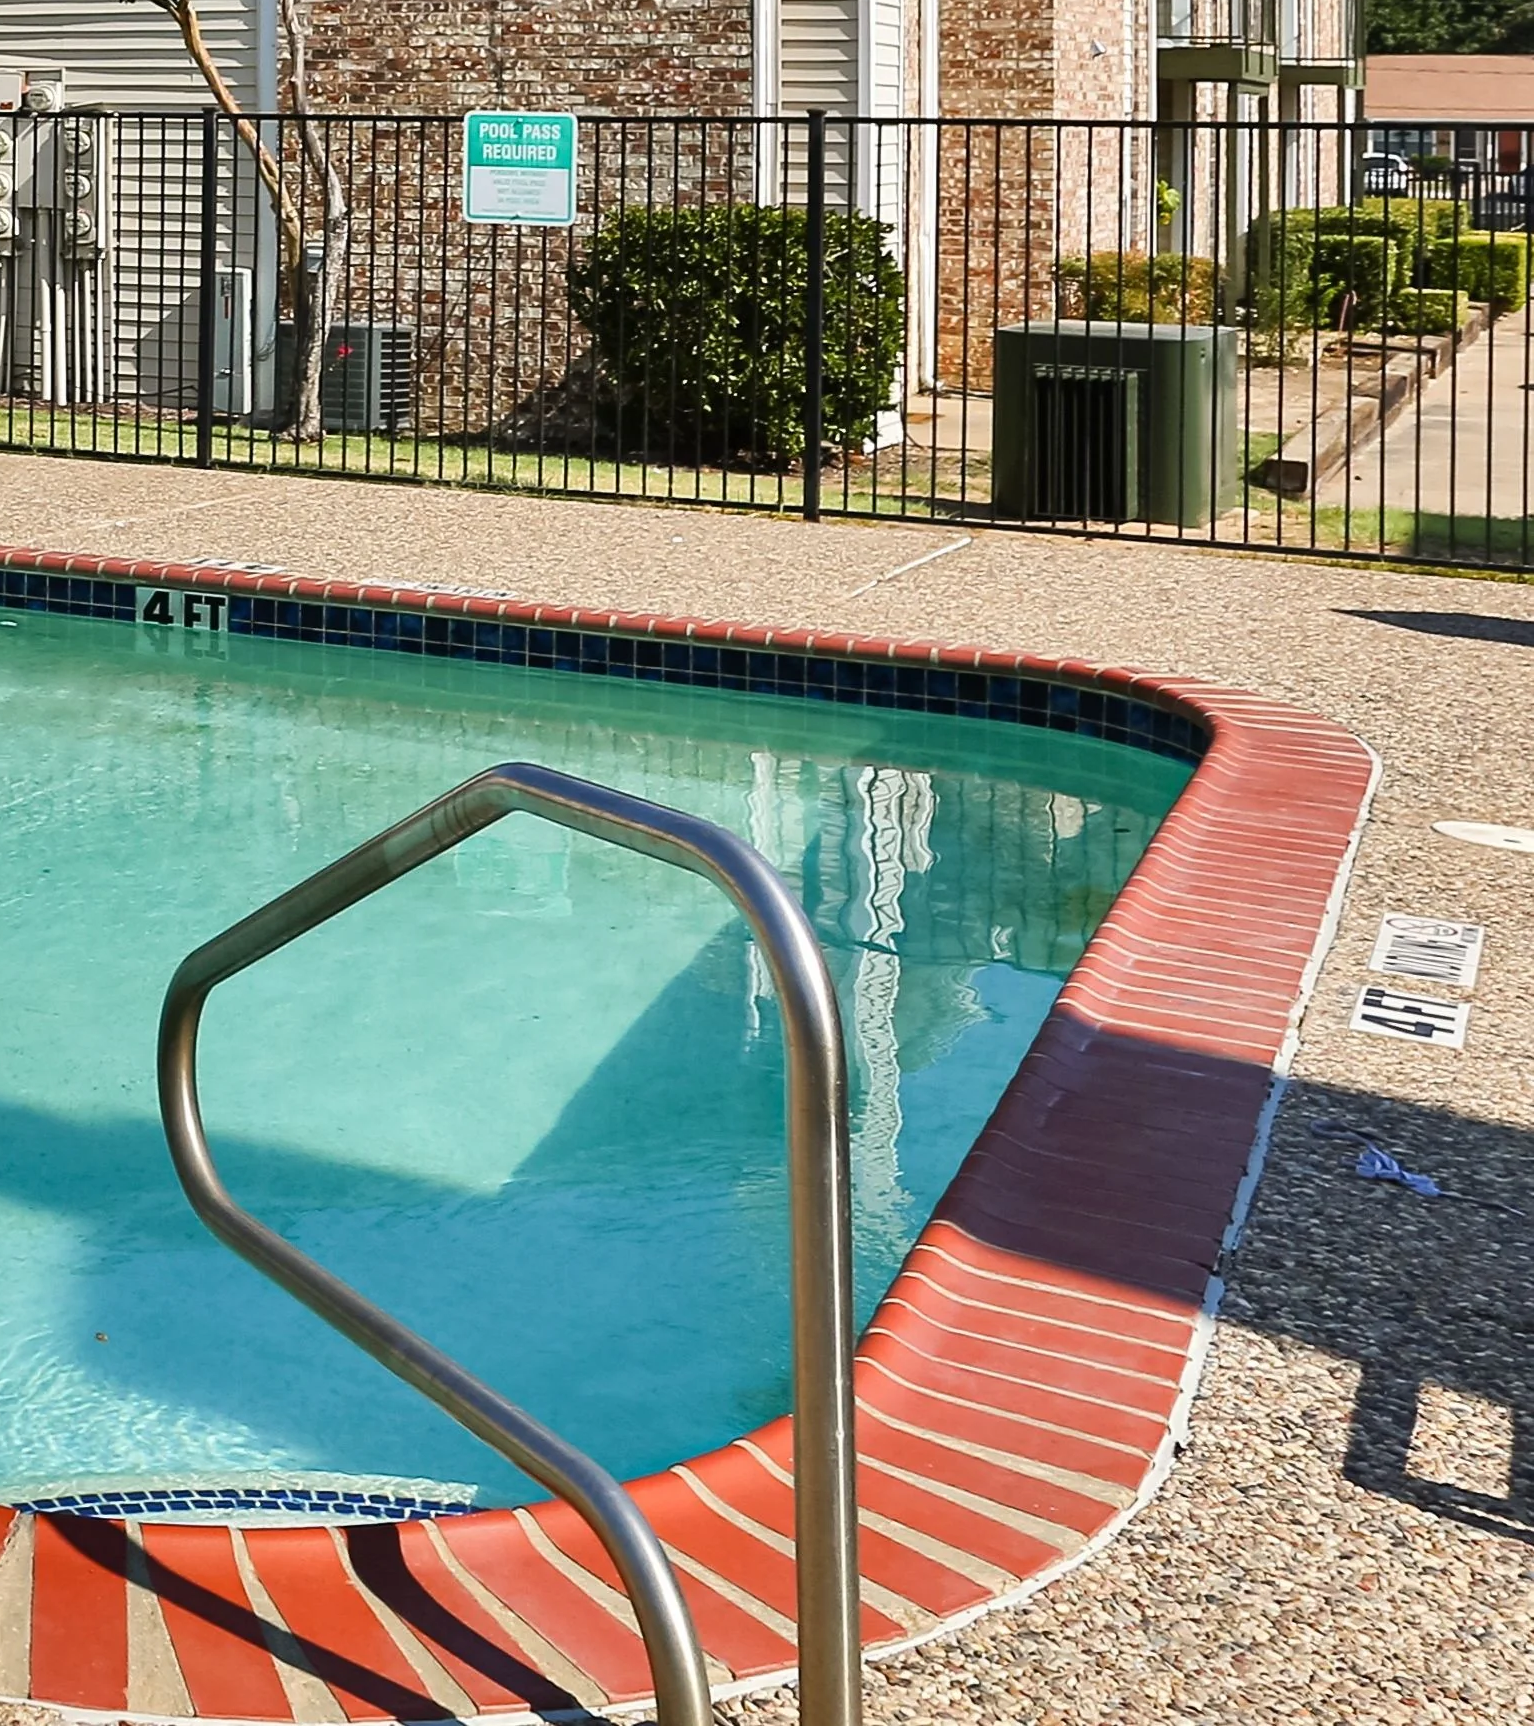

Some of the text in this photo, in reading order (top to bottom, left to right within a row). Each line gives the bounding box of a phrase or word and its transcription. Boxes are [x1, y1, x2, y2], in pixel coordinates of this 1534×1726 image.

[479, 123, 561, 140] POOL PASS
[483, 143, 557, 161] REQUIRED
[143, 591, 226, 631] 4 FT
[1361, 988, 1459, 1038] 4 FT
